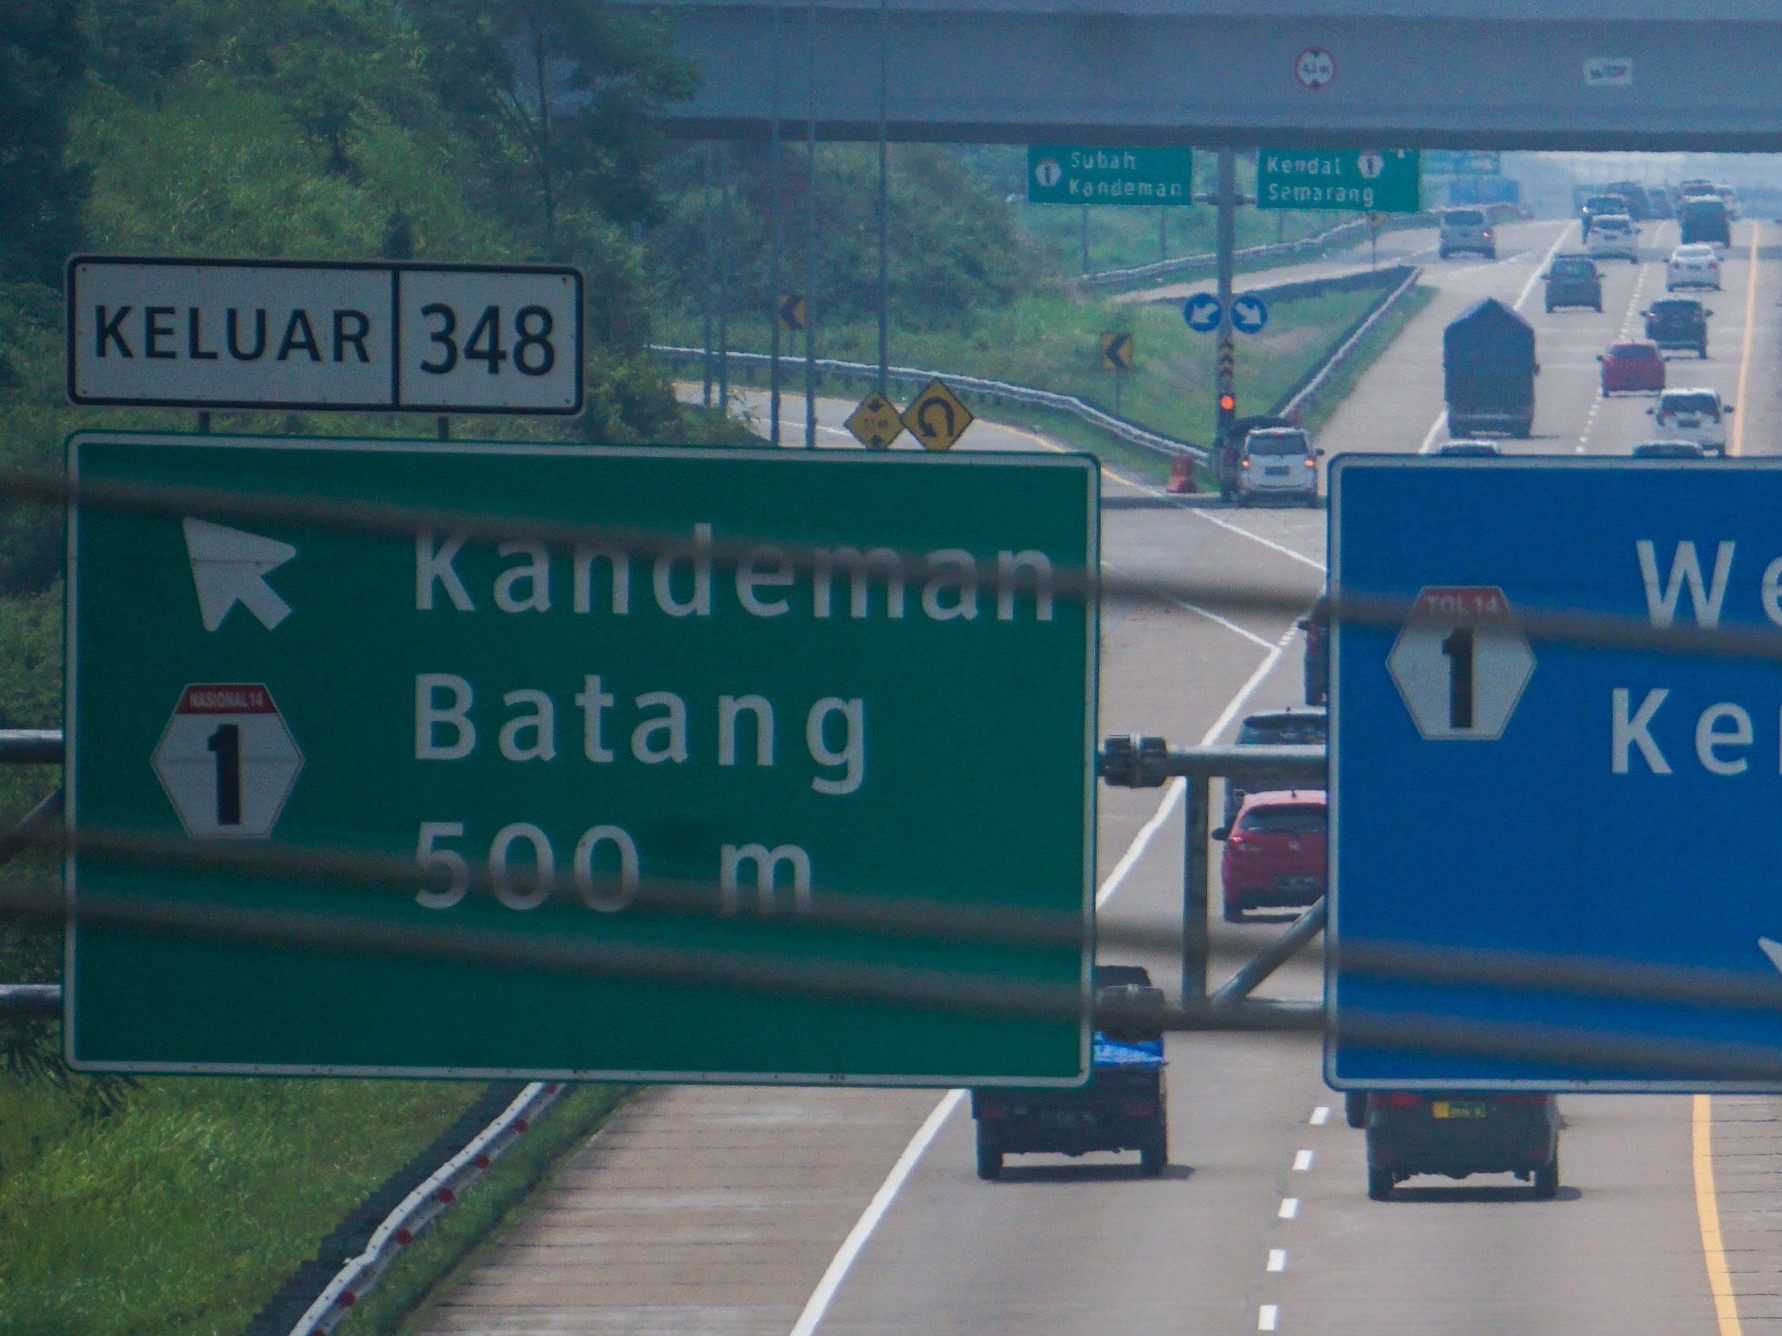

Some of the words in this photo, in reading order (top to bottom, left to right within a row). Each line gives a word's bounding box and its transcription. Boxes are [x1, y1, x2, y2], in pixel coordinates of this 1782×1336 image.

[1068, 178, 1181, 197] Kandeman
[1070, 151, 1136, 169] Subah
[1268, 183, 1374, 207] Semarang
[96, 305, 371, 364] KELUAR
[420, 302, 556, 377] 348
[415, 522, 1056, 622] Kandeman
[1442, 627, 1474, 729] 1
[206, 723, 242, 826] 1
[413, 672, 867, 796] Batang
[413, 820, 641, 913] 500
[718, 837, 812, 918] m
